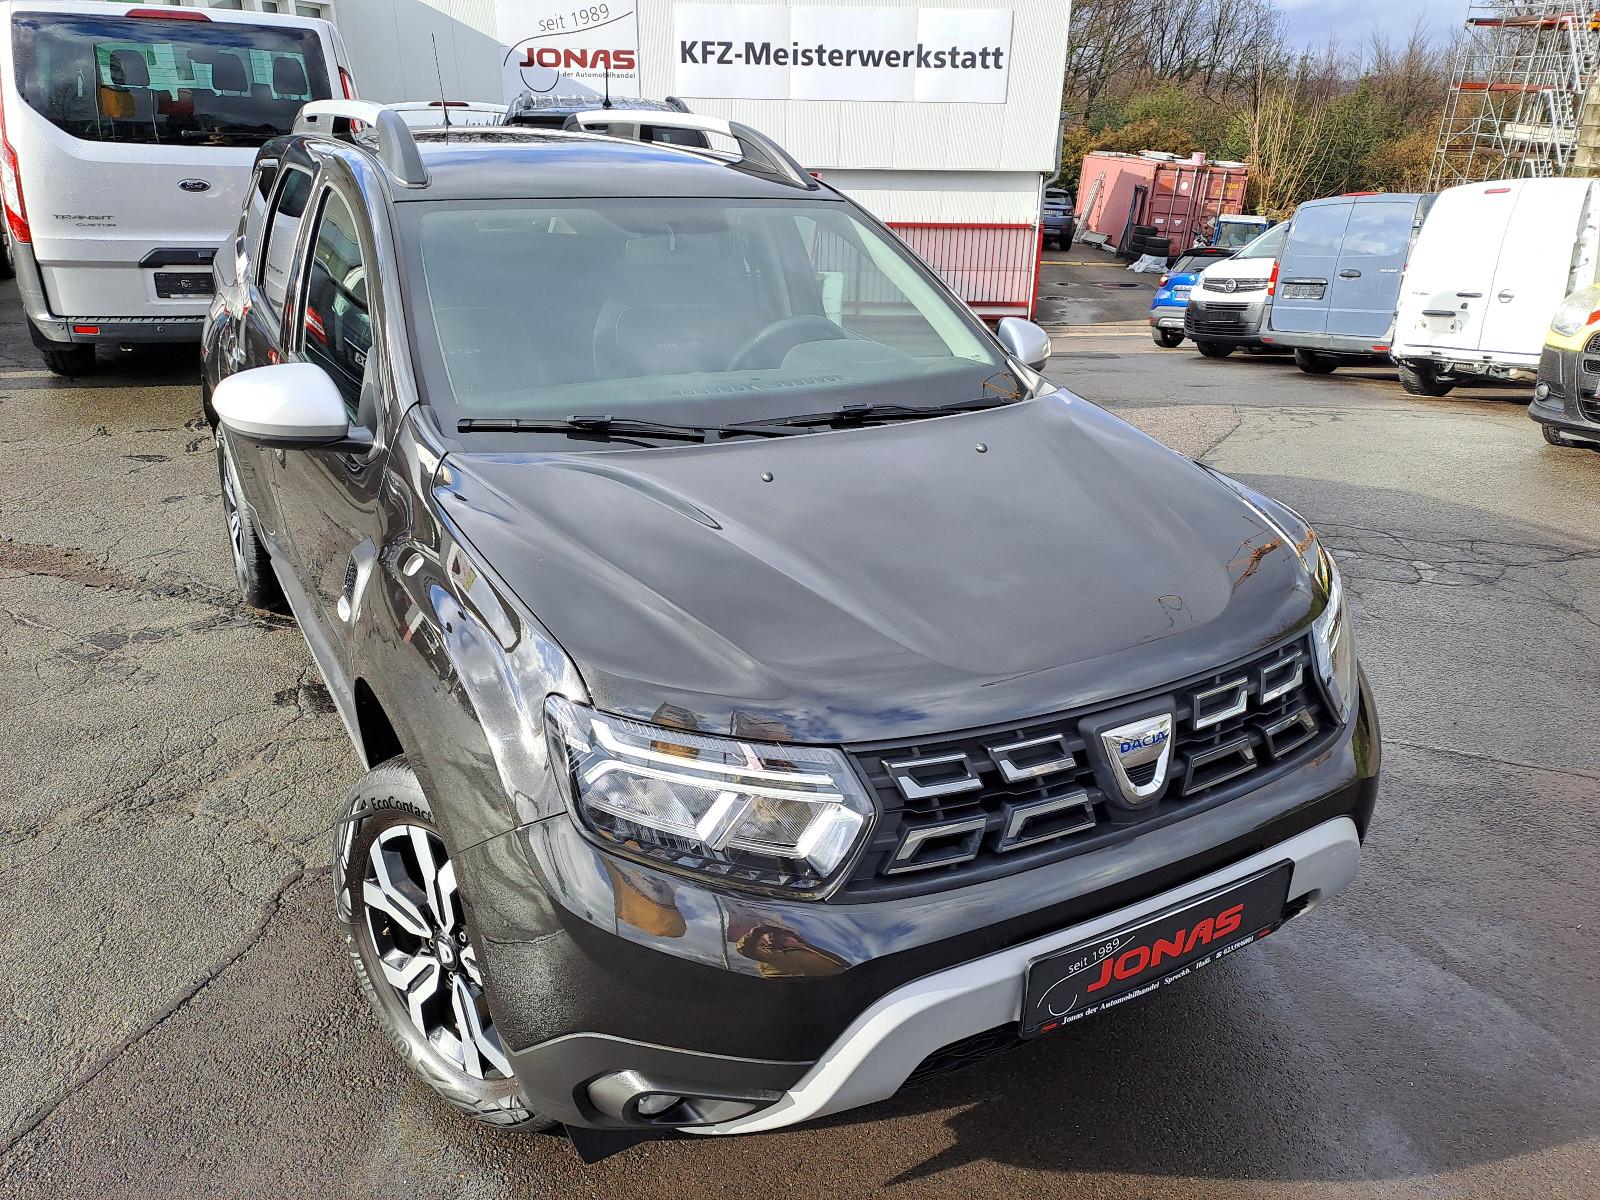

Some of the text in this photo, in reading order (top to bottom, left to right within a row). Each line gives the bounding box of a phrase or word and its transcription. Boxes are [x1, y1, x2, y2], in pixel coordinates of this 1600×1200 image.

[538, 3, 610, 32] seit 1989
[519, 47, 636, 70] JONAS
[680, 40, 1004, 70] KFZ-Meisterwerkstatt
[1120, 731, 1166, 754] DACIA
[370, 796, 433, 825] EcoContact
[1068, 938, 1120, 974] seit 1989
[1086, 903, 1245, 993] JONAS
[1061, 1012, 1084, 1025] Jonas
[1085, 1006, 1099, 1016] der
[1099, 981, 1160, 1011] Automobilhandel
